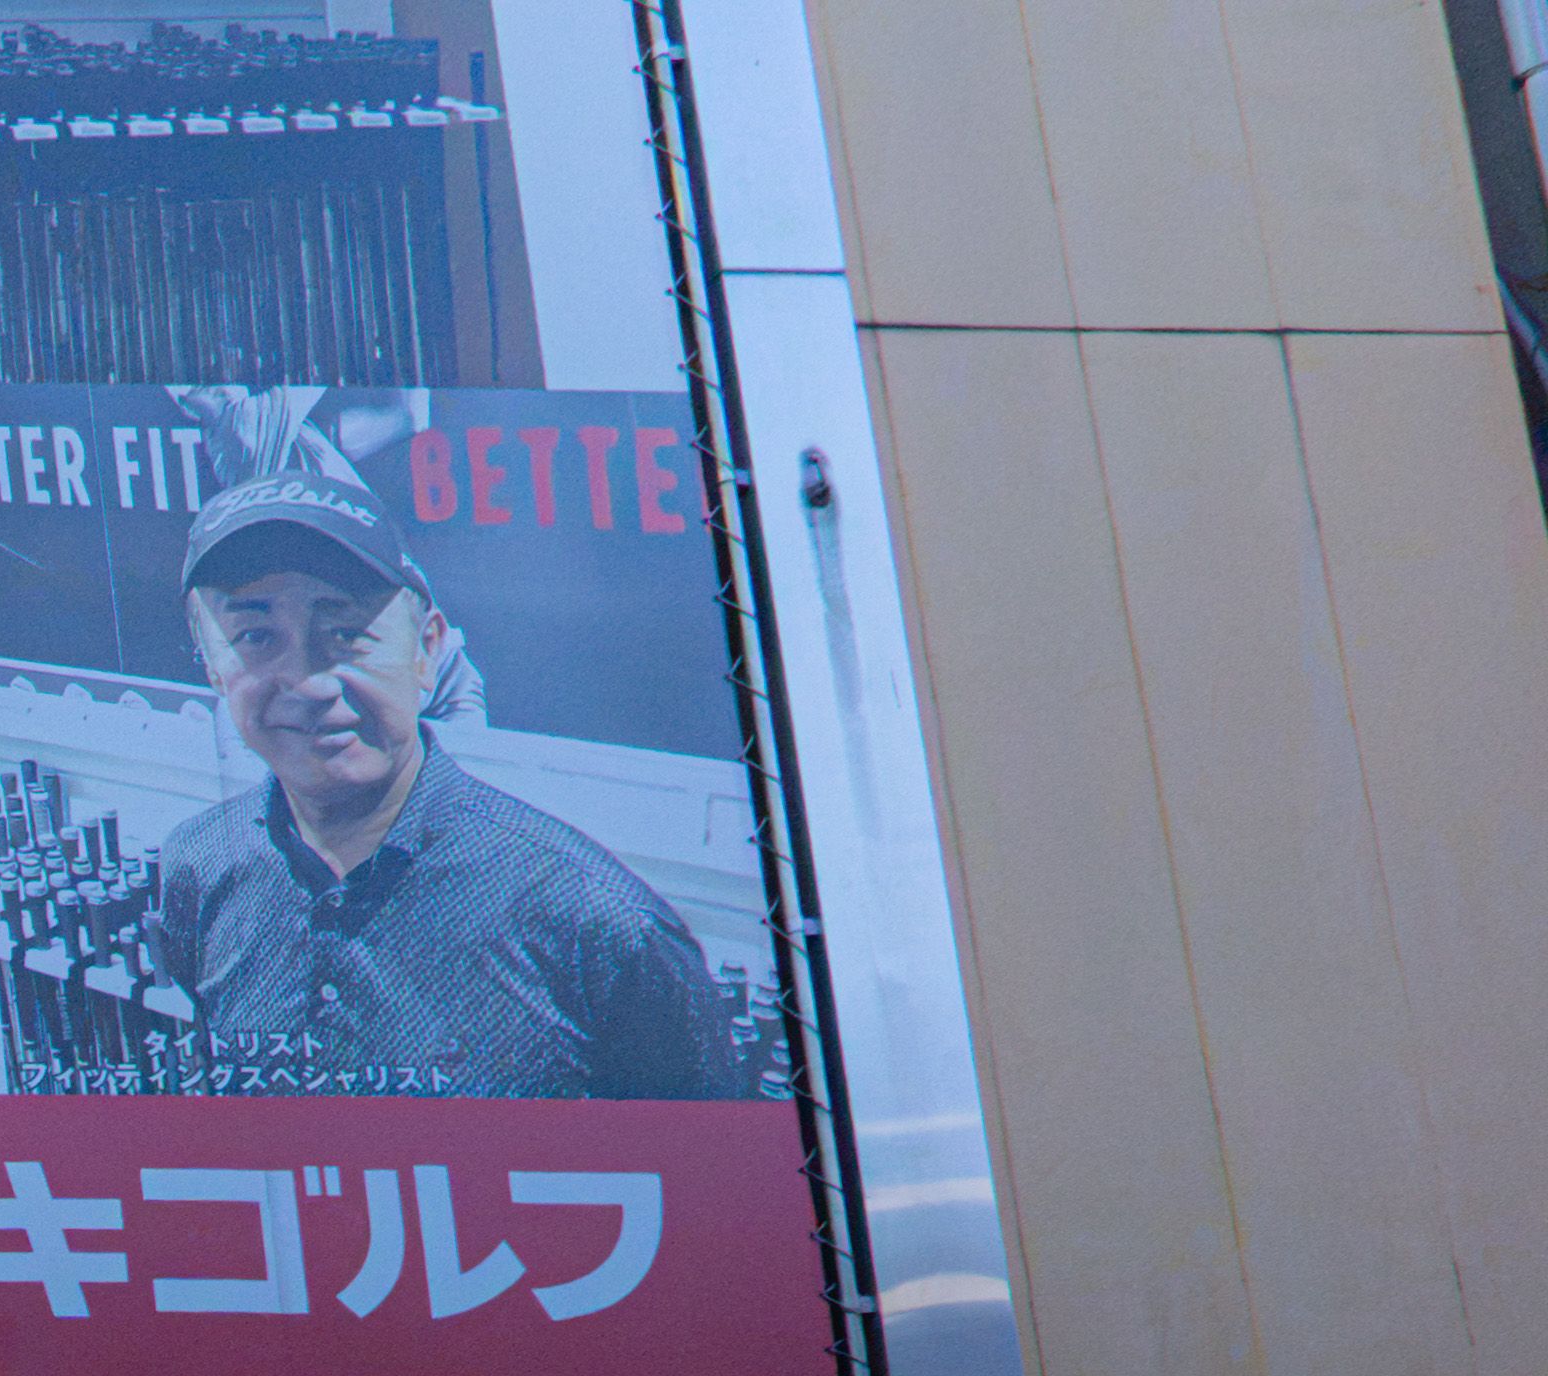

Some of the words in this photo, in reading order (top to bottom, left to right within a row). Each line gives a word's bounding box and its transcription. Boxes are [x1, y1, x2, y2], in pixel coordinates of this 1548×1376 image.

[113, 426, 202, 512] FIT
[410, 425, 709, 534] BETTE
[143, 1029, 325, 1056] タイトリスト
[20, 1062, 454, 1092] フィッティングスペシャリスト
